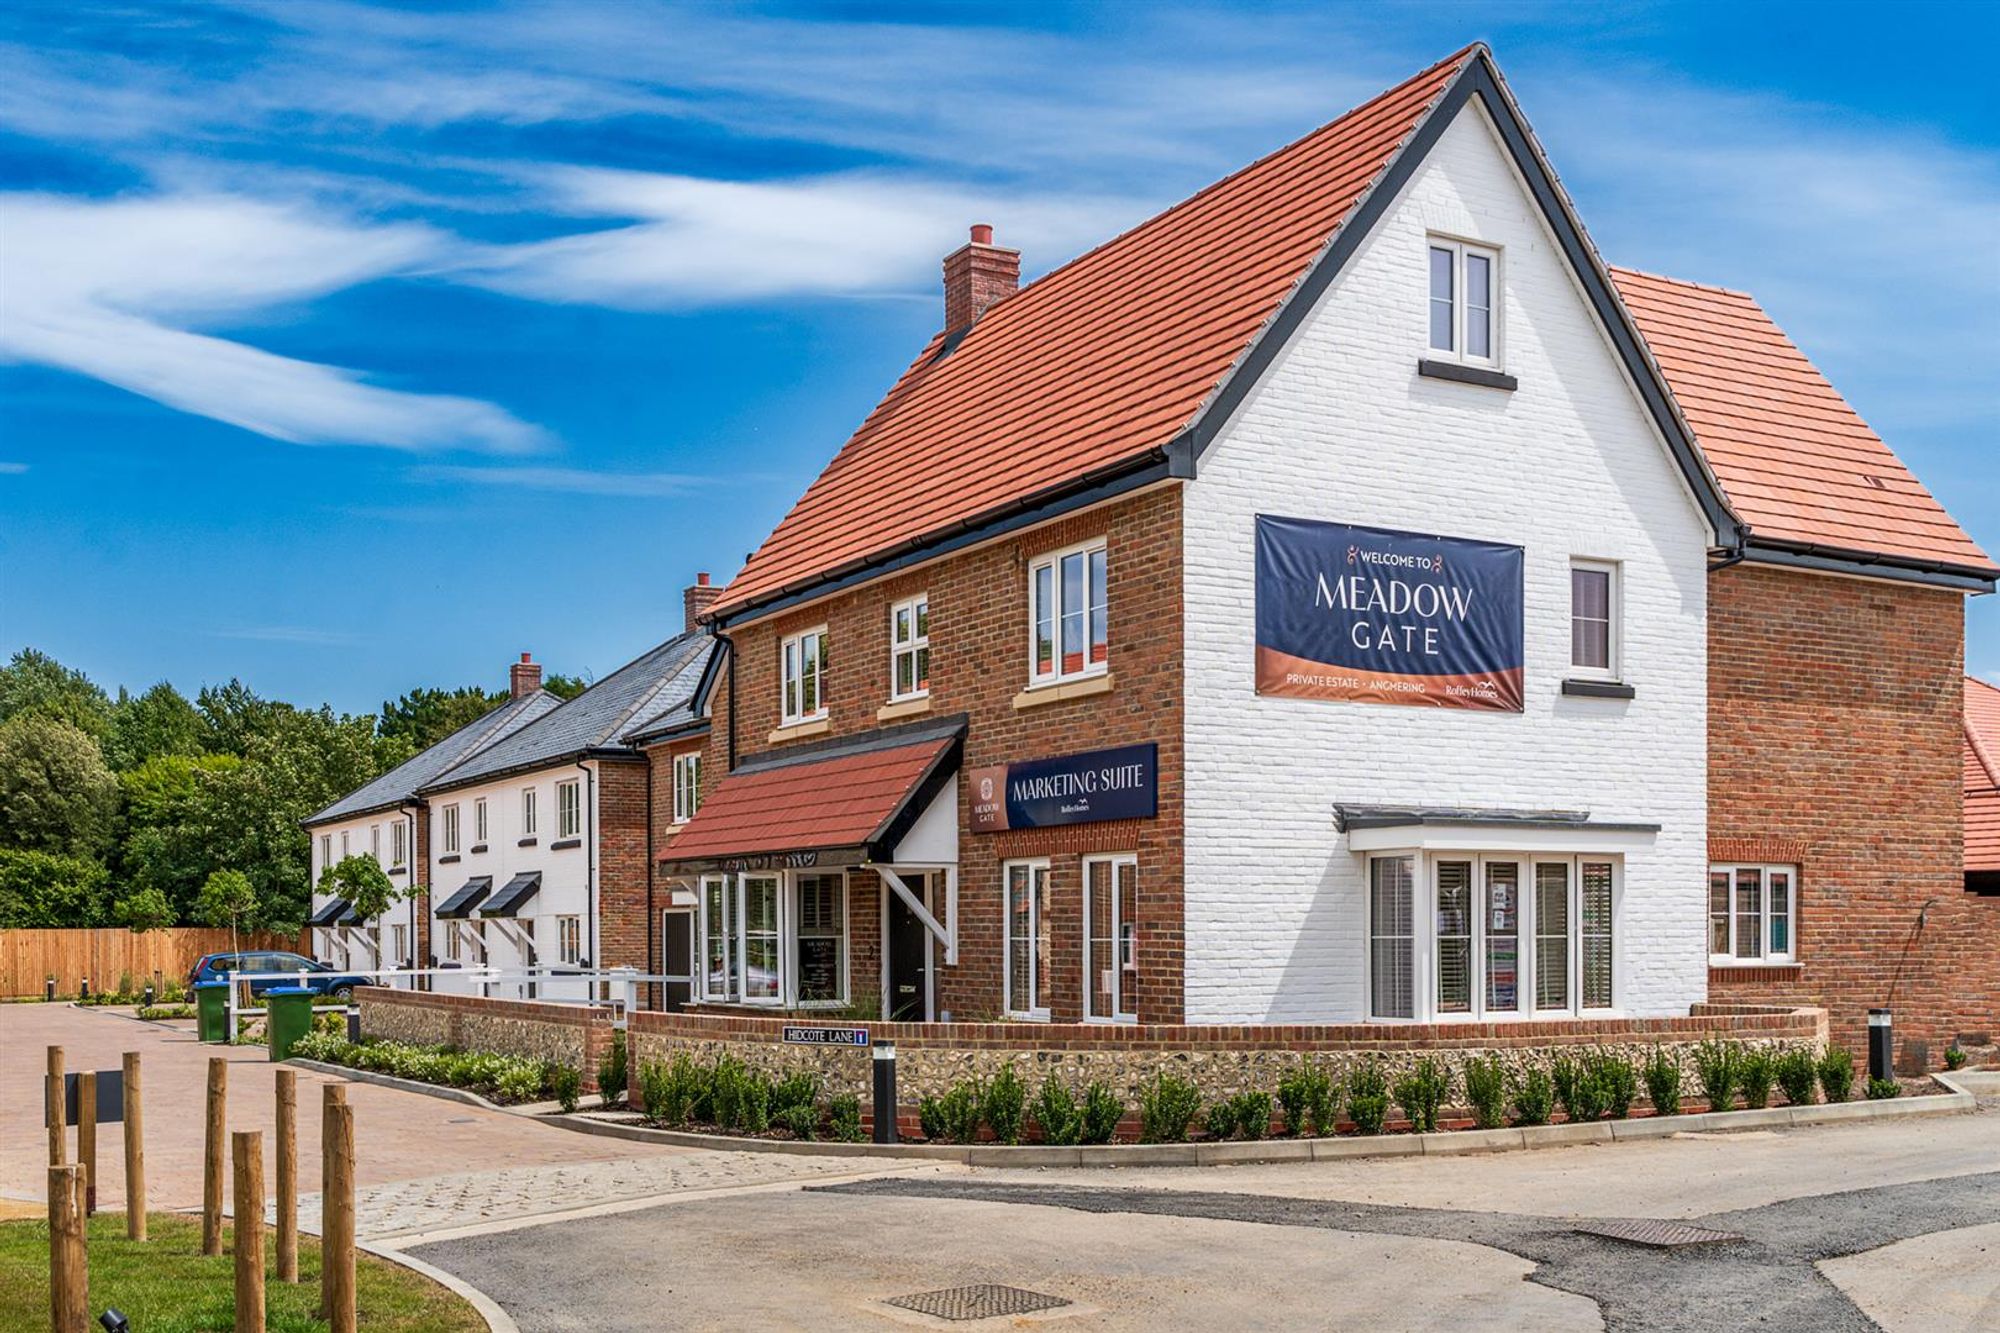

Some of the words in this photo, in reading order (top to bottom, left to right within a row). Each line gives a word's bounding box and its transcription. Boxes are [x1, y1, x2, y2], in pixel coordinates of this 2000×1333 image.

[1360, 550, 1414, 568] WELCOME
[1415, 557, 1431, 570] TO
[1315, 571, 1473, 622] MEADOW
[1351, 621, 1439, 655] GATE
[1287, 673, 1326, 687] PRIVATE
[1327, 676, 1359, 689] ESTATE
[1369, 680, 1425, 694] ANGMERING
[1013, 770, 1096, 802] MARKETING
[1100, 764, 1143, 792] SUITE
[788, 1029, 825, 1041] HIDCOTE
[829, 1031, 853, 1042] LANE
